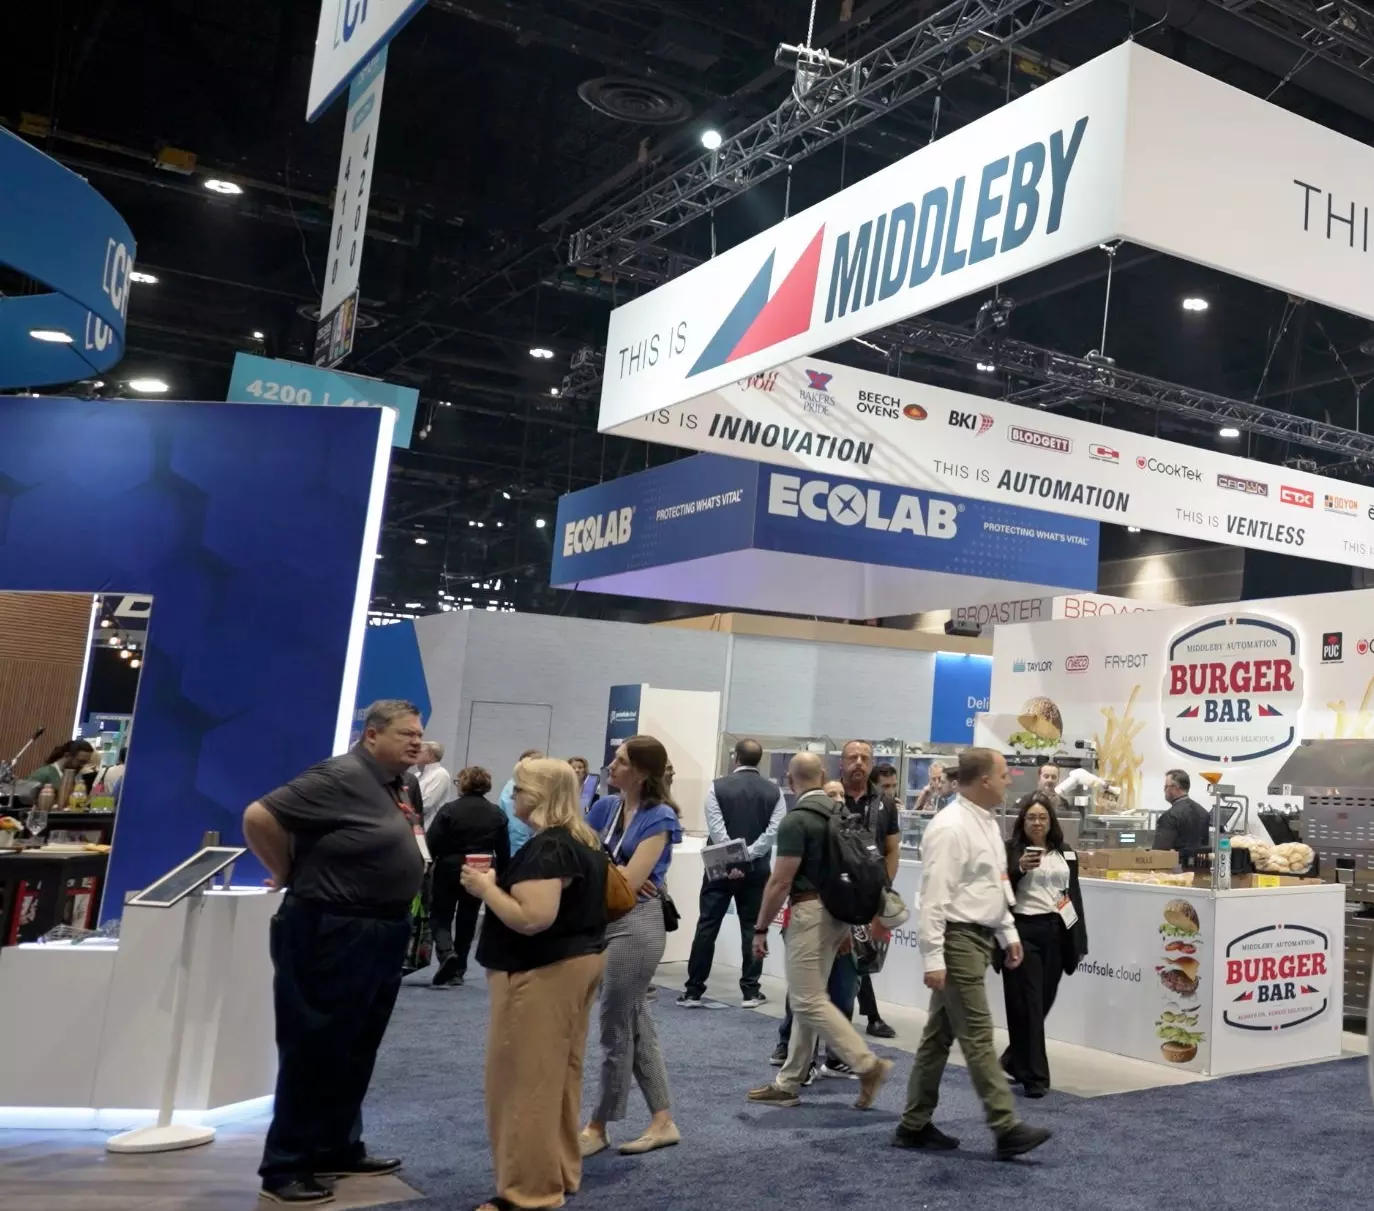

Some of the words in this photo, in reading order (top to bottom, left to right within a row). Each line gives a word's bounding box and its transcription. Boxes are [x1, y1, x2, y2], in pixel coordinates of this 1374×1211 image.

[824, 115, 1090, 324] MIDDLEBY
[619, 333, 661, 380] THIS
[668, 320, 688, 359] IS
[246, 378, 312, 405] 4200
[799, 389, 836, 407] BAKERS
[858, 390, 901, 409] BEECH
[803, 400, 831, 416] PRIDE
[856, 402, 900, 420] OVENS
[948, 410, 978, 431] BKI
[680, 413, 698, 430] IS
[708, 413, 875, 466] INNOVATION
[1011, 427, 1070, 452] BLODGETT
[1147, 457, 1203, 483] CookTek
[933, 459, 970, 480] THIS
[976, 468, 991, 483] IS
[997, 468, 1131, 514] AUTOMATION
[655, 503, 696, 522] PROTECTING
[695, 494, 722, 512] WHAT'S
[983, 521, 1035, 539] PROTECTING
[1036, 529, 1066, 543] WHAT'S
[1175, 508, 1204, 526] THIS
[1208, 516, 1220, 529] IS
[1226, 514, 1306, 547] VENTLESS
[1343, 540, 1367, 556] THIS
[956, 598, 1043, 625] BROASTER
[1187, 644, 1223, 653] MIDDLEBY
[1226, 639, 1278, 651] AUTOMATION
[1323, 643, 1340, 658] PUC
[1027, 661, 1053, 673] TAYLOR
[1104, 653, 1149, 670] FRYBOT
[1169, 658, 1295, 696] BURGER
[966, 695, 990, 712] Deli
[1204, 698, 1253, 723] BAR
[1241, 943, 1274, 952] MIDDLEBY
[1275, 939, 1316, 949] AUTOMATION
[1226, 952, 1328, 985] BURGER
[1257, 981, 1297, 1004] BAR
